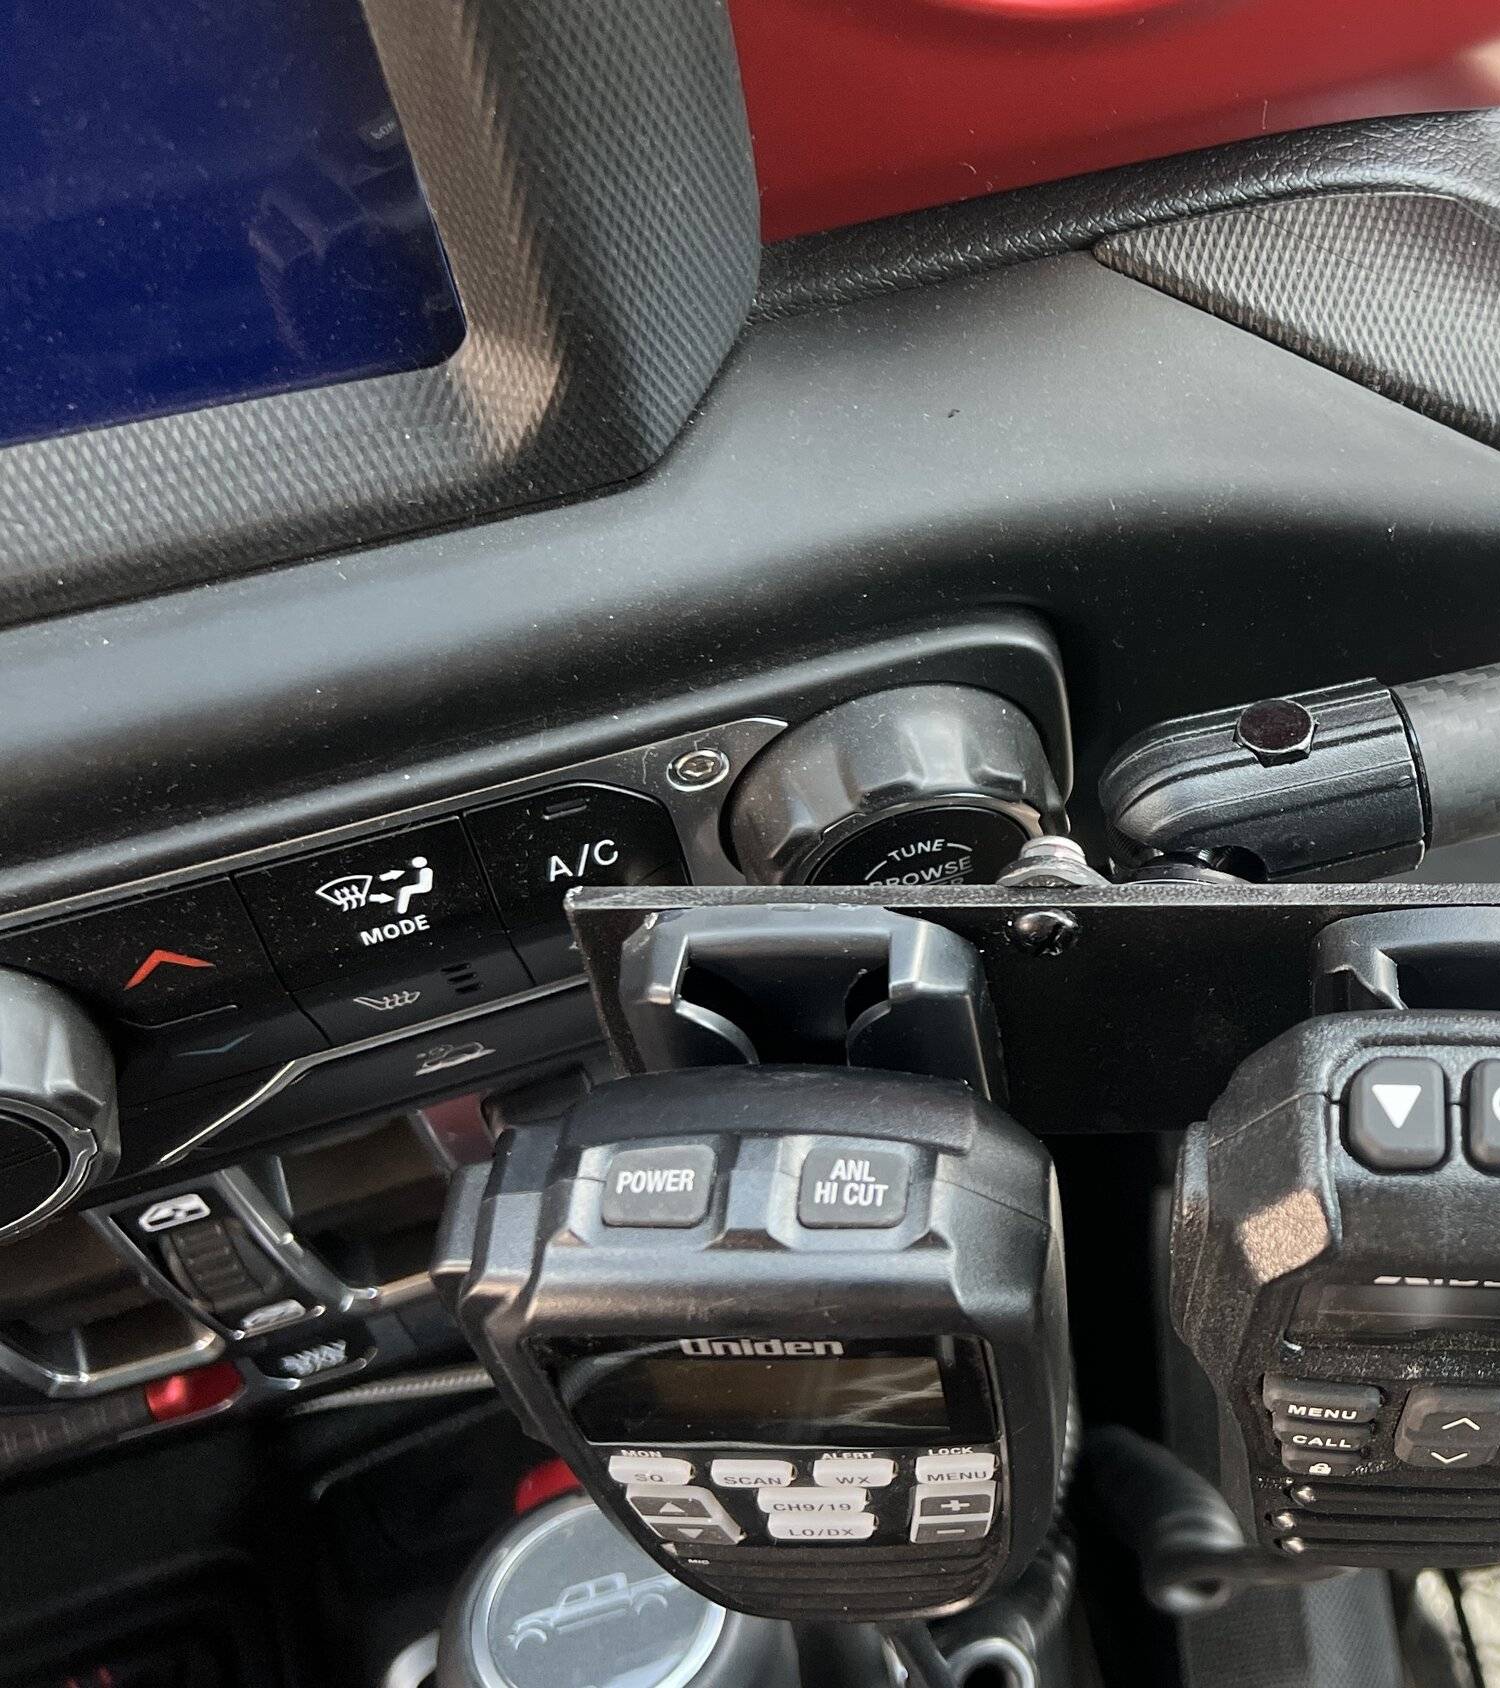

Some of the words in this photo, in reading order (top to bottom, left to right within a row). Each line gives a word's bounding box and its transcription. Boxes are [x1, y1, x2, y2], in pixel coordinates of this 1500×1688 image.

[887, 838, 945, 863] TUNE
[549, 839, 619, 882] A/C
[868, 855, 972, 886] ROWSE
[360, 914, 430, 946] MODE
[830, 1159, 876, 1182] ANL
[616, 1169, 695, 1194] POWER
[814, 1181, 837, 1204] HI
[842, 1184, 889, 1207] CUT
[679, 1338, 844, 1356] Uniden
[1287, 1404, 1357, 1420] MENU
[1292, 1435, 1351, 1448] CALL
[928, 1447, 974, 1456] LOCK
[634, 1474, 664, 1482] SQ
[723, 1477, 782, 1486] SCAN
[836, 1476, 872, 1485] WX
[926, 1471, 987, 1483] MENU
[773, 1503, 851, 1512] CH9/19
[789, 1528, 856, 1537] LO/DX
